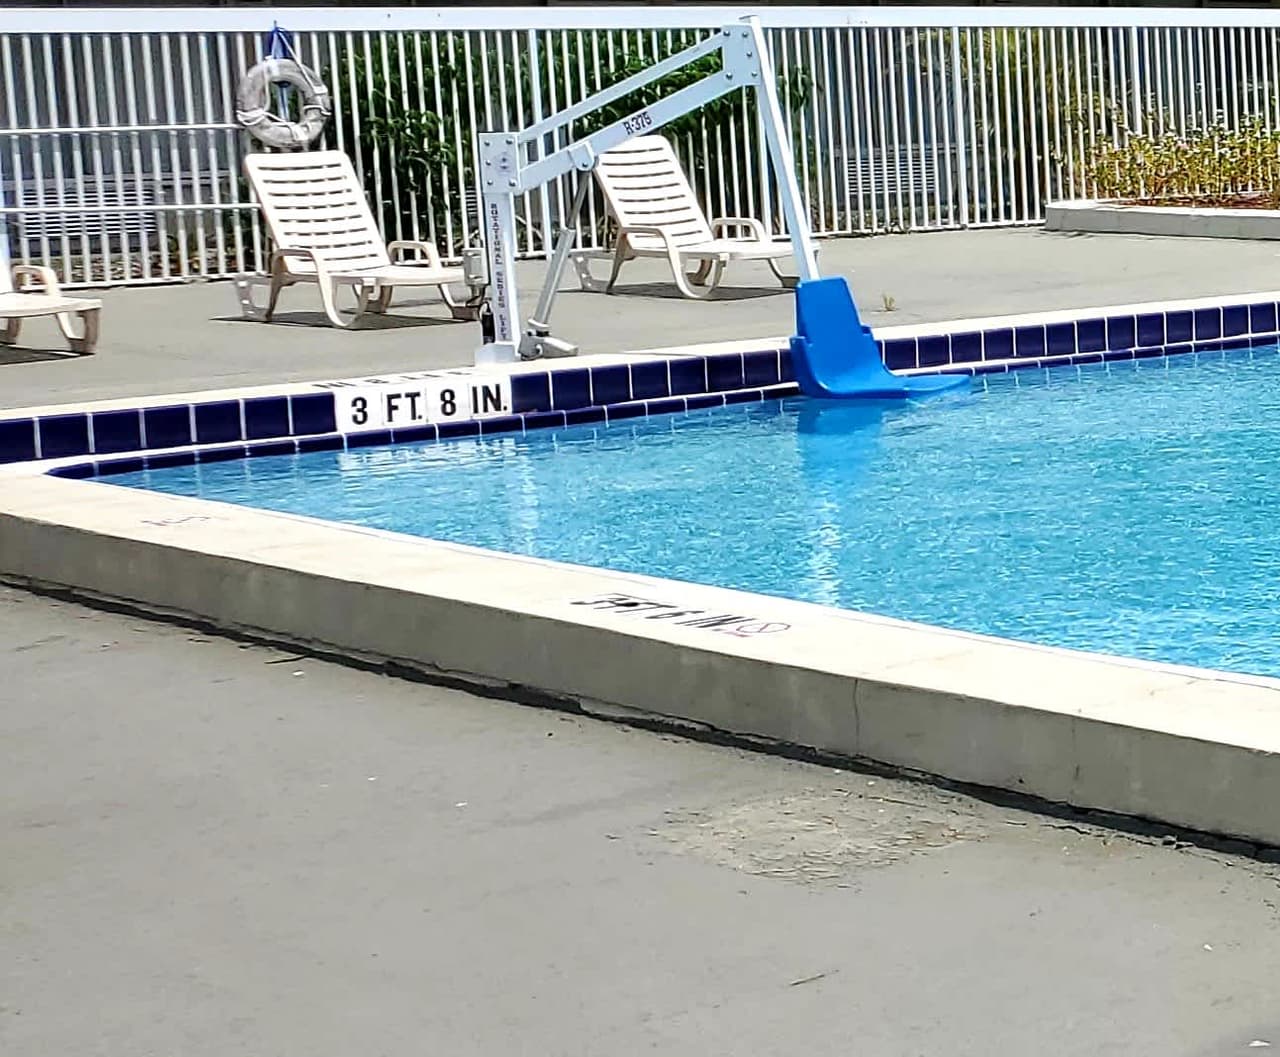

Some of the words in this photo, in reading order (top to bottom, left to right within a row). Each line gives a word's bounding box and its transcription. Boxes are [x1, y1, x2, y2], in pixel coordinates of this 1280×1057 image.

[351, 396, 369, 425] 3
[386, 391, 423, 422] FT.
[440, 389, 457, 416] 8
[472, 383, 508, 414] IN.
